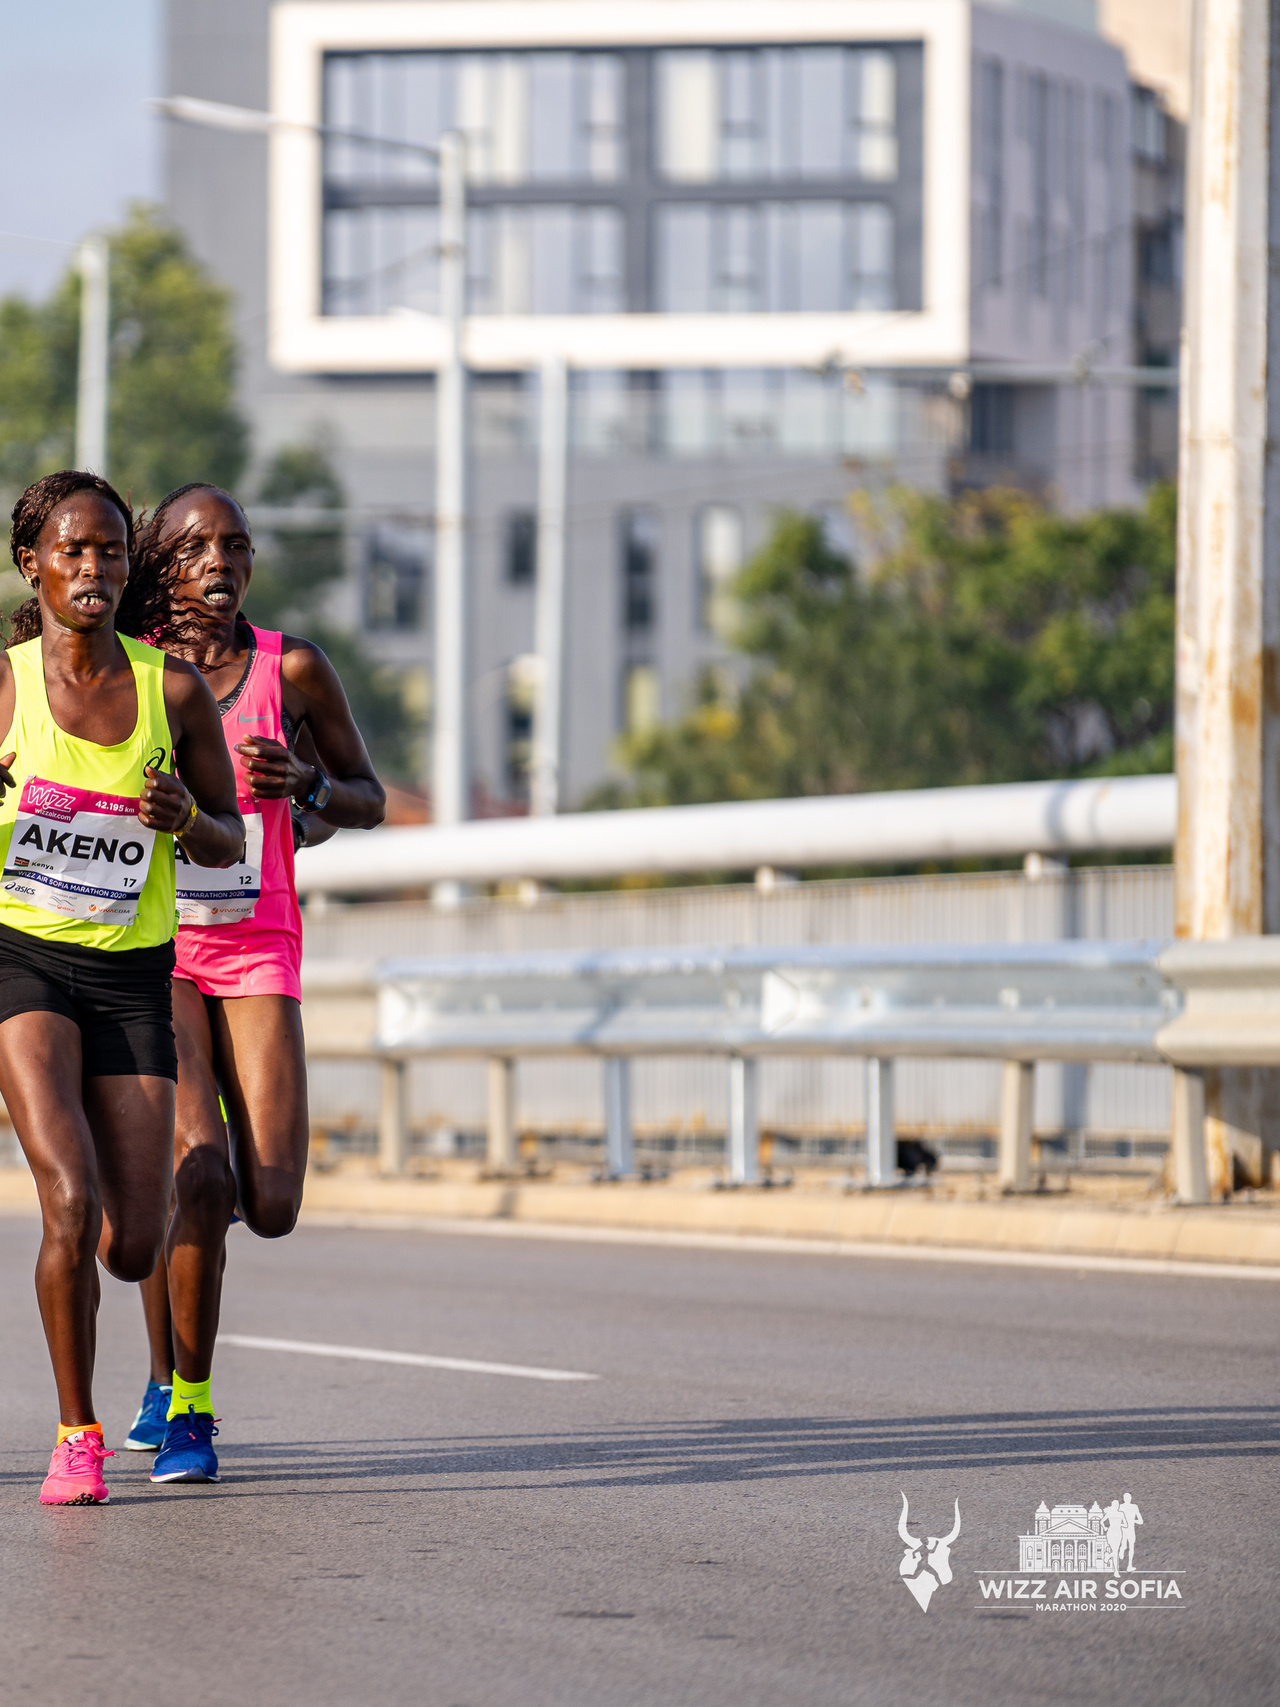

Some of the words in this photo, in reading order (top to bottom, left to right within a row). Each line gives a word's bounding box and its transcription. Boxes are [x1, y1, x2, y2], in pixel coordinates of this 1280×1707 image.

[95, 800, 124, 812] 42.195
[34, 807, 72, 822] wizzair.com
[18, 823, 145, 866] AKENO
[31, 860, 55, 871] Kenya
[18, 871, 36, 879] WIZZ
[36, 875, 48, 883] AIR
[48, 879, 69, 889] SOFIA
[70, 883, 110, 897] MARATHON
[110, 891, 127, 899] 2020
[123, 878, 137, 888] 17
[239, 876, 252, 885] 12
